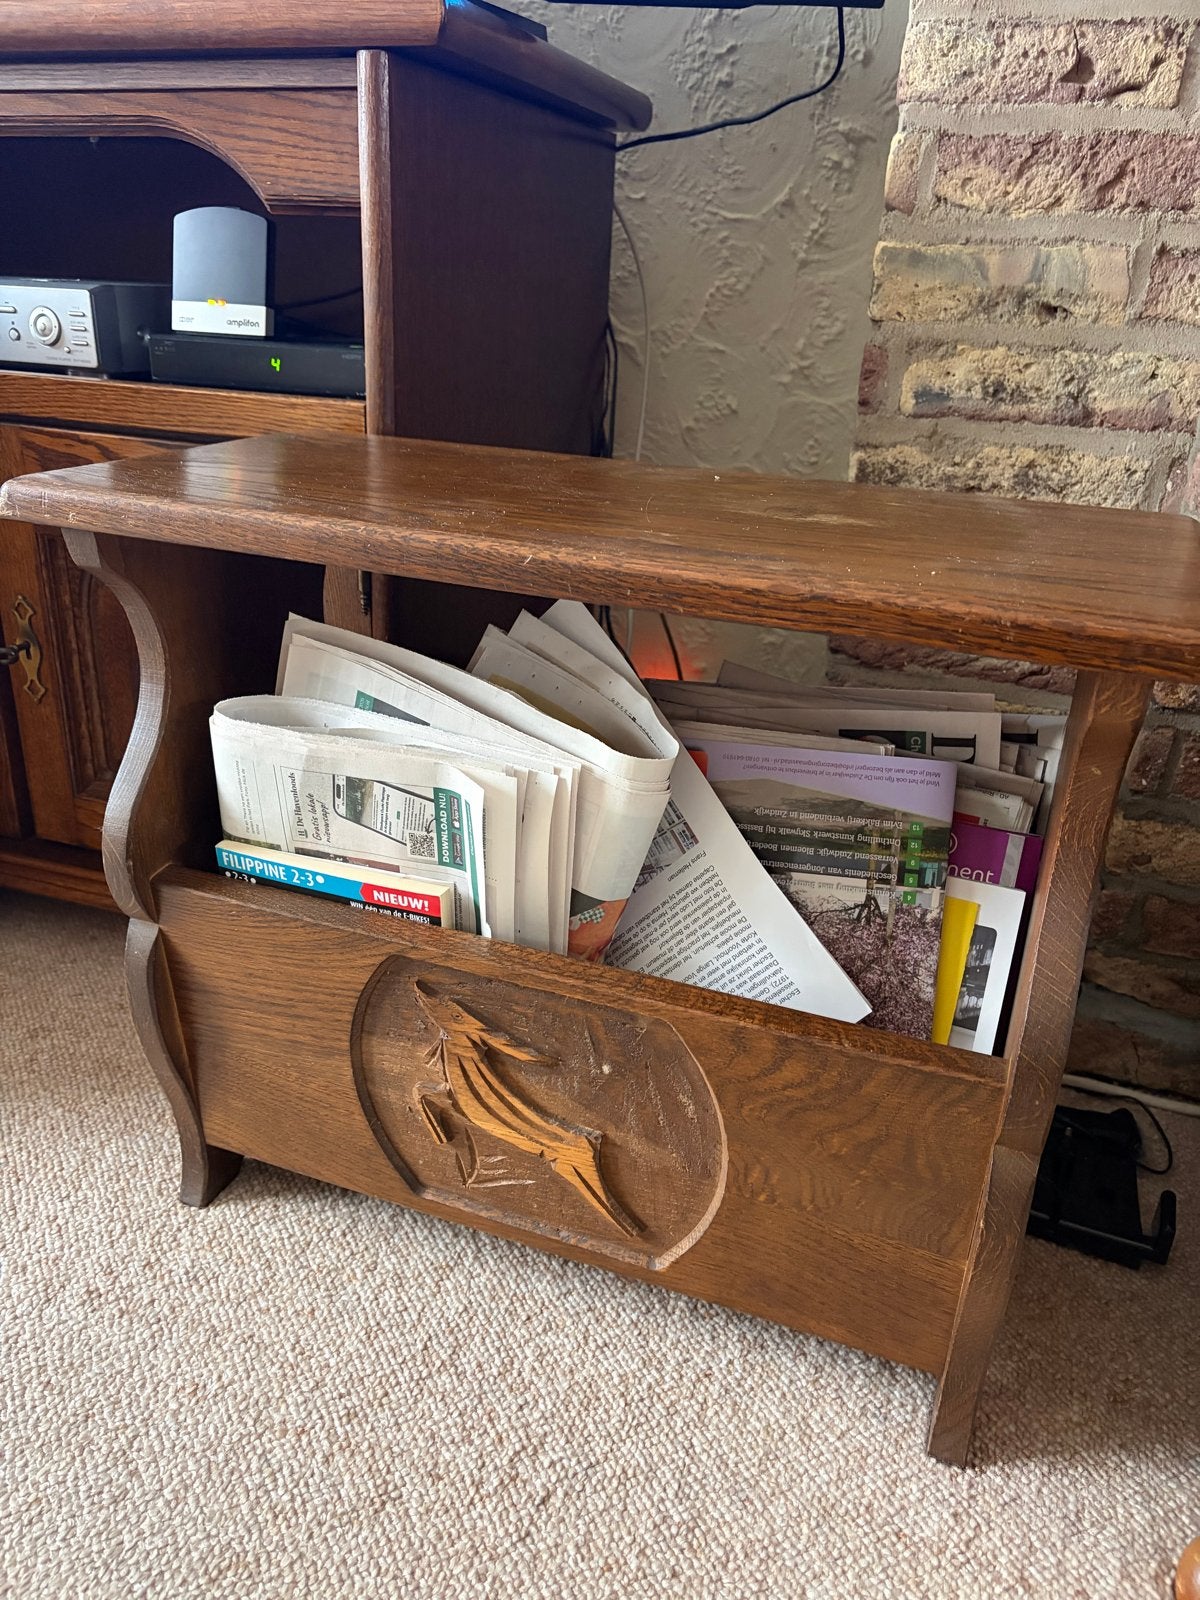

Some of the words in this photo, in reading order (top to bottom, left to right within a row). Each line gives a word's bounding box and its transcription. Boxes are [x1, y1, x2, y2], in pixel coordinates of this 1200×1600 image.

[226, 318, 260, 328] amplifon
[271, 358, 281, 372] 4
[287, 771, 301, 816] Havenloods
[305, 792, 316, 814] lokale
[753, 805, 787, 817] Zuidwijk
[789, 810, 797, 818] in
[799, 811, 845, 823] verbindend
[295, 816, 303, 826] De
[317, 798, 333, 843] nieuwsapp!
[846, 814, 880, 826] Bakkerij
[882, 819, 902, 829] Evim
[309, 816, 321, 840] Gratis
[765, 824, 776, 834] bij
[778, 825, 810, 837] Skywalk
[439, 810, 449, 862] DOWNLOAD
[812, 830, 854, 841] kunstwerk
[856, 833, 901, 846] Onthulling
[779, 844, 814, 855] Bloemen
[690, 849, 707, 866] Frans
[854, 852, 898, 864] Verrassend
[222, 851, 287, 881] FILIPPINE
[291, 868, 314, 888] 2-3
[666, 861, 692, 884] Helleman
[691, 863, 715, 885] Capelse
[843, 868, 897, 881] Geschiedenis
[698, 871, 720, 891] hebben
[713, 879, 723, 889] De
[675, 880, 694, 897] dames
[689, 886, 698, 895] we
[703, 885, 715, 897] foto
[720, 886, 727, 894] In
[835, 884, 895, 899] Kennismaking
[372, 889, 430, 912] NIEUW!
[667, 892, 677, 902] bij
[692, 893, 704, 905] met
[712, 891, 721, 900] de
[659, 899, 670, 909] het
[679, 901, 694, 915] Ludo
[680, 895, 714, 923] paleiswinkel
[699, 892, 733, 919] inpakpapier
[725, 900, 737, 912] gaf
[392, 908, 402, 919] de
[403, 911, 431, 925] E-BIKES!
[634, 905, 662, 928] standbeeld
[650, 910, 669, 925] Hierna
[666, 911, 680, 924] werd
[715, 907, 727, 918] een
[656, 919, 667, 929] per
[669, 919, 683, 932] werd
[690, 915, 701, 926] van
[696, 914, 716, 932] aparte
[736, 915, 746, 925] De
[624, 925, 635, 934] van
[637, 924, 646, 933] op
[659, 928, 671, 939] ook
[682, 923, 692, 932] de
[718, 921, 738, 938] mooie
[733, 922, 752, 939] mooie
[620, 935, 633, 946] weg
[631, 931, 640, 940] de
[642, 927, 659, 942] e-mail
[648, 934, 660, 946] nog
[683, 928, 699, 941] sfeer
[700, 930, 711, 940] het
[740, 930, 757, 945] Korte
[673, 937, 685, 947] aan
[675, 935, 701, 957] prachtige
[754, 937, 763, 946] In
[640, 943, 651, 954] wat
[666, 945, 675, 954] dit
[712, 939, 741, 963] Voorhout,
[731, 942, 756, 962] verband
[755, 944, 767, 955] een
[681, 953, 692, 964] het
[720, 958, 733, 970] met
[724, 951, 756, 976] koninklijke
[751, 952, 773, 969] Escher
[694, 958, 714, 975] Lange
[705, 966, 720, 978] weer
[735, 965, 753, 980] blinkt
[747, 958, 779, 983] Daarnaast
[698, 976, 706, 984] en
[720, 981, 729, 991] uit
[727, 976, 736, 984] ze
[735, 979, 747, 990] was
[743, 964, 784, 996] vlakvullingen,
[778, 987, 800, 1005] Escher
